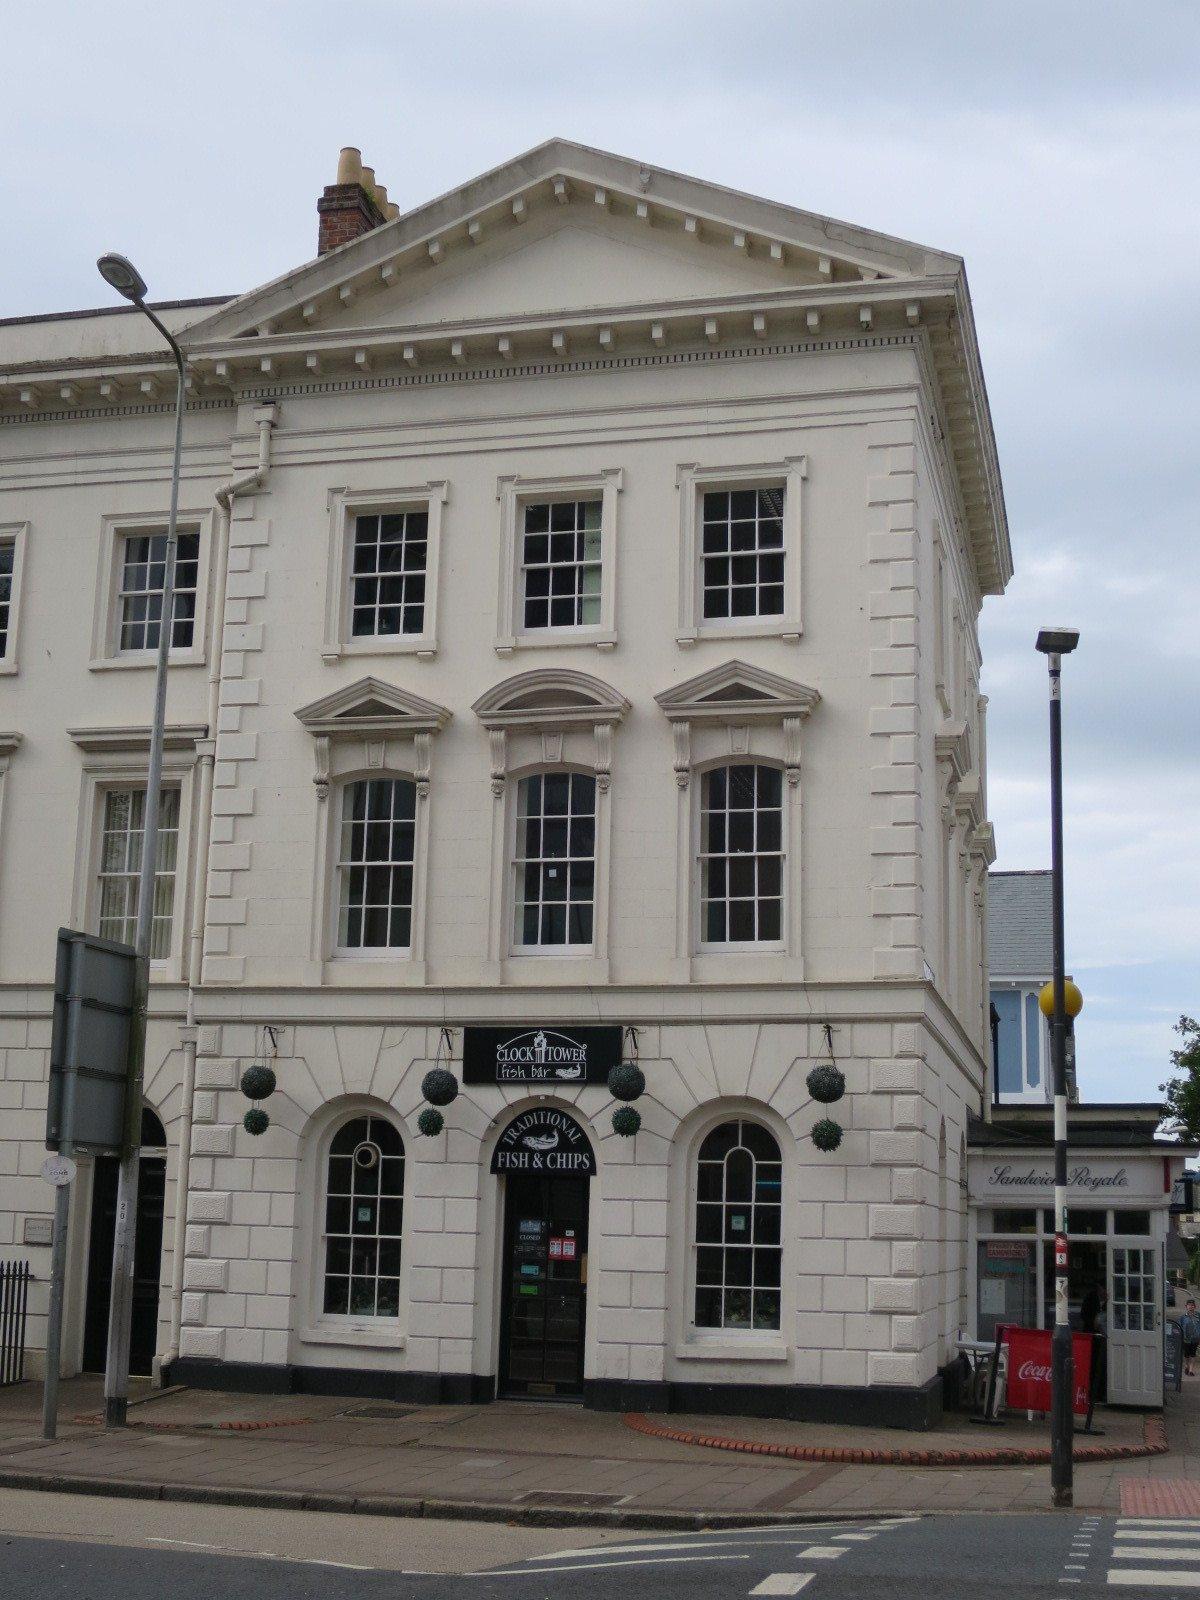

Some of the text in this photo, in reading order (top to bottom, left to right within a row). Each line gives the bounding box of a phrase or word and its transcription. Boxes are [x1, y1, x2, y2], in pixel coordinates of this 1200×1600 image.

[496, 1046, 587, 1062] CLOCK TOWER
[501, 1063, 551, 1079] fish bar
[502, 1110, 582, 1146] TRADITIONAL
[497, 1151, 590, 1169] FISH & CHIPS
[988, 1165, 1129, 1192] Sandwic Royale
